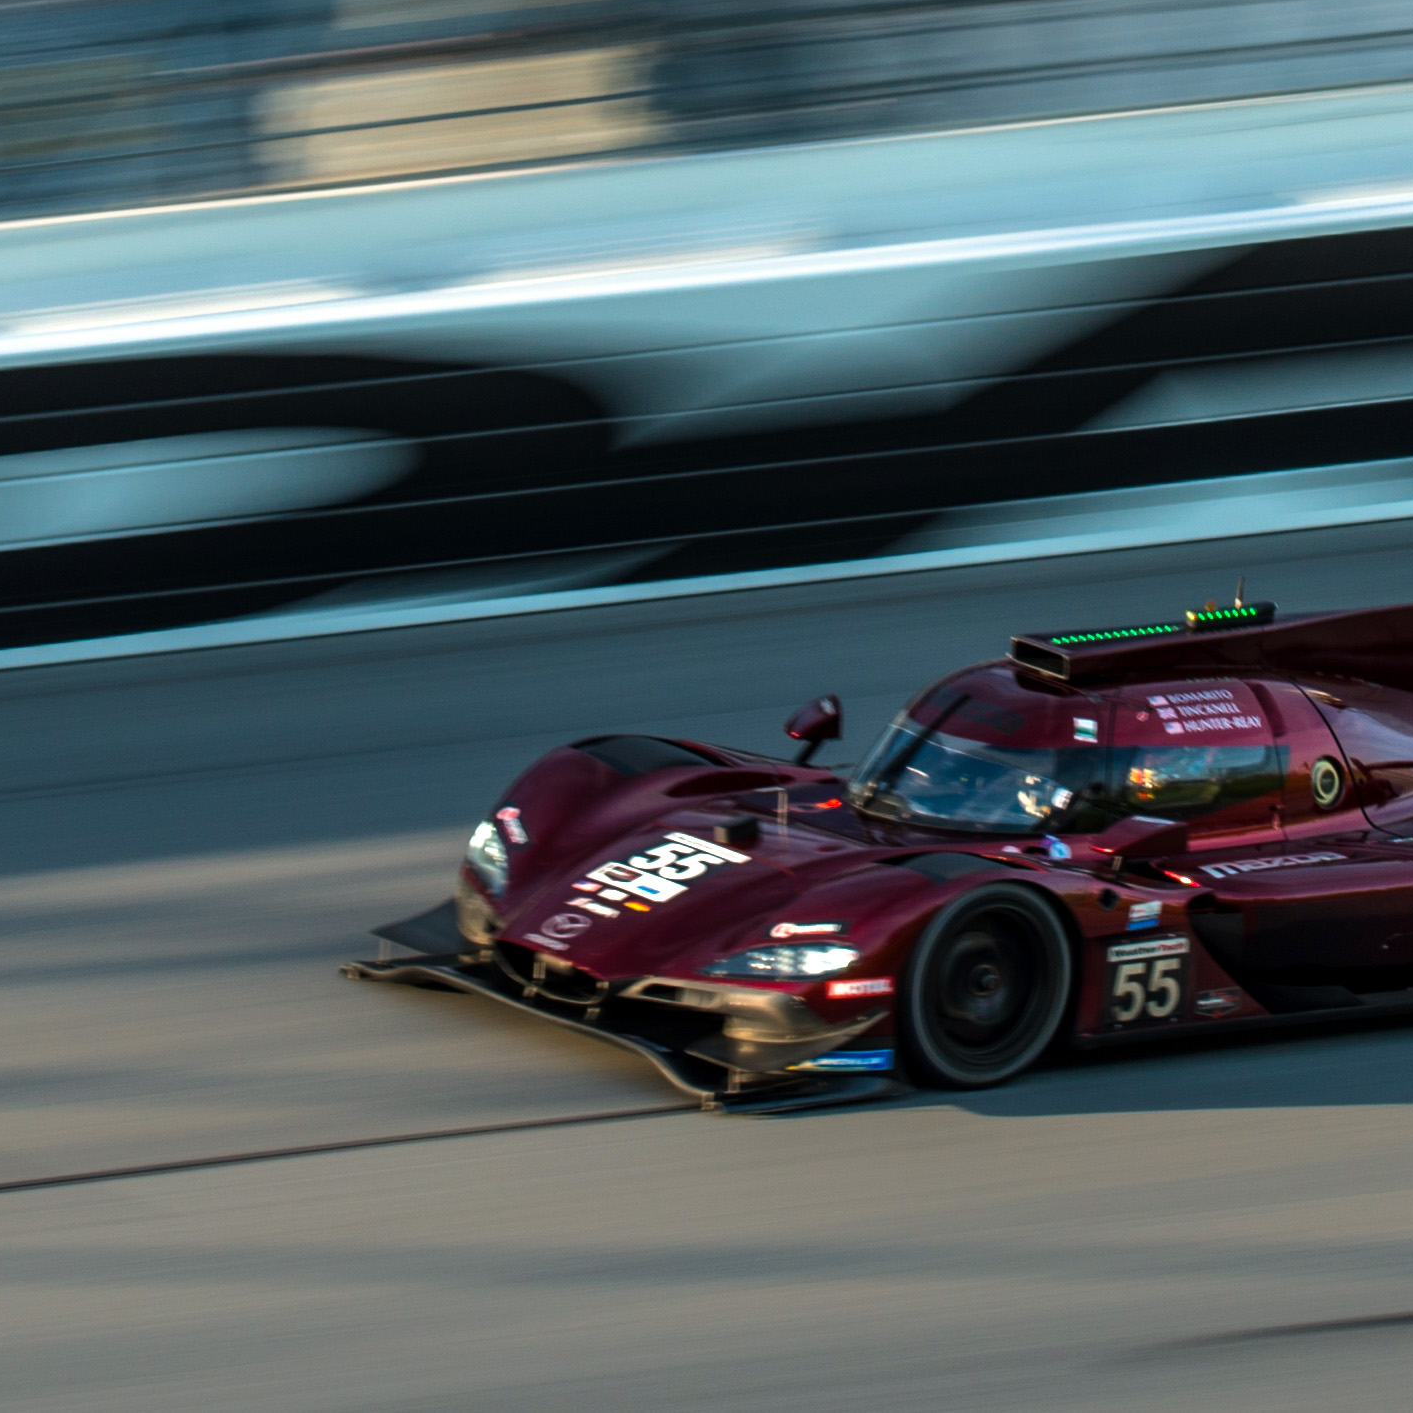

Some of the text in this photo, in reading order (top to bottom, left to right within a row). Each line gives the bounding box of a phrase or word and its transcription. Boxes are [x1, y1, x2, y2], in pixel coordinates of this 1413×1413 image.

[628, 842, 727, 881] 55
[1113, 941, 1186, 958] WeatherTech
[1111, 957, 1182, 1022] 55
